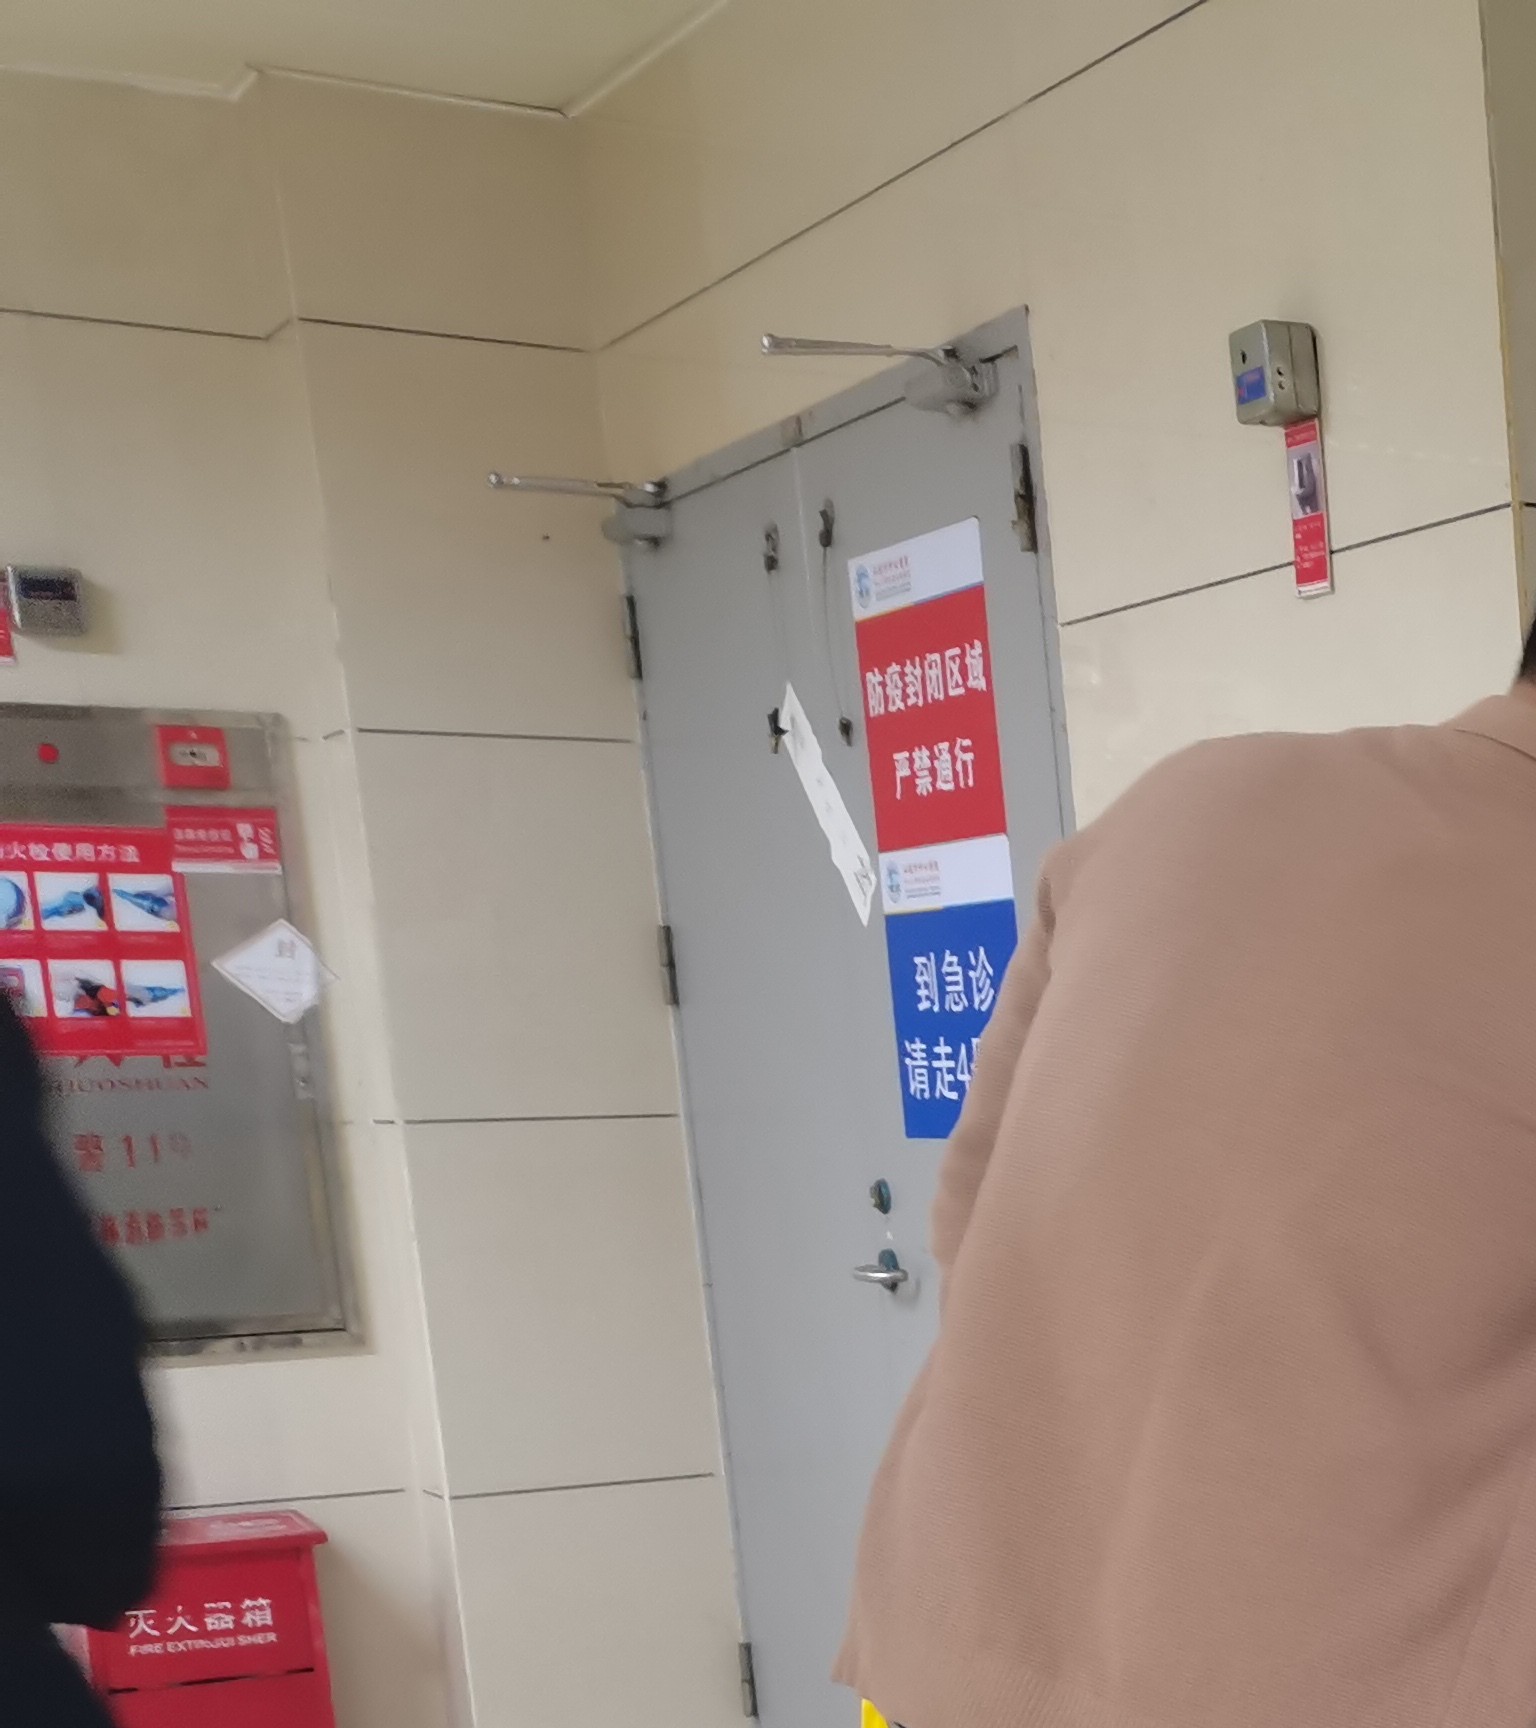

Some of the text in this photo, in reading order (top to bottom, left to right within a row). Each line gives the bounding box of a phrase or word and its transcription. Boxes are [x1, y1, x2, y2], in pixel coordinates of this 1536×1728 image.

[865, 638, 988, 718] 防疫封闭区域
[892, 736, 975, 801] 严禁通行
[913, 946, 995, 1014] 到急诊
[125, 1597, 274, 1639] 灭火器箱
